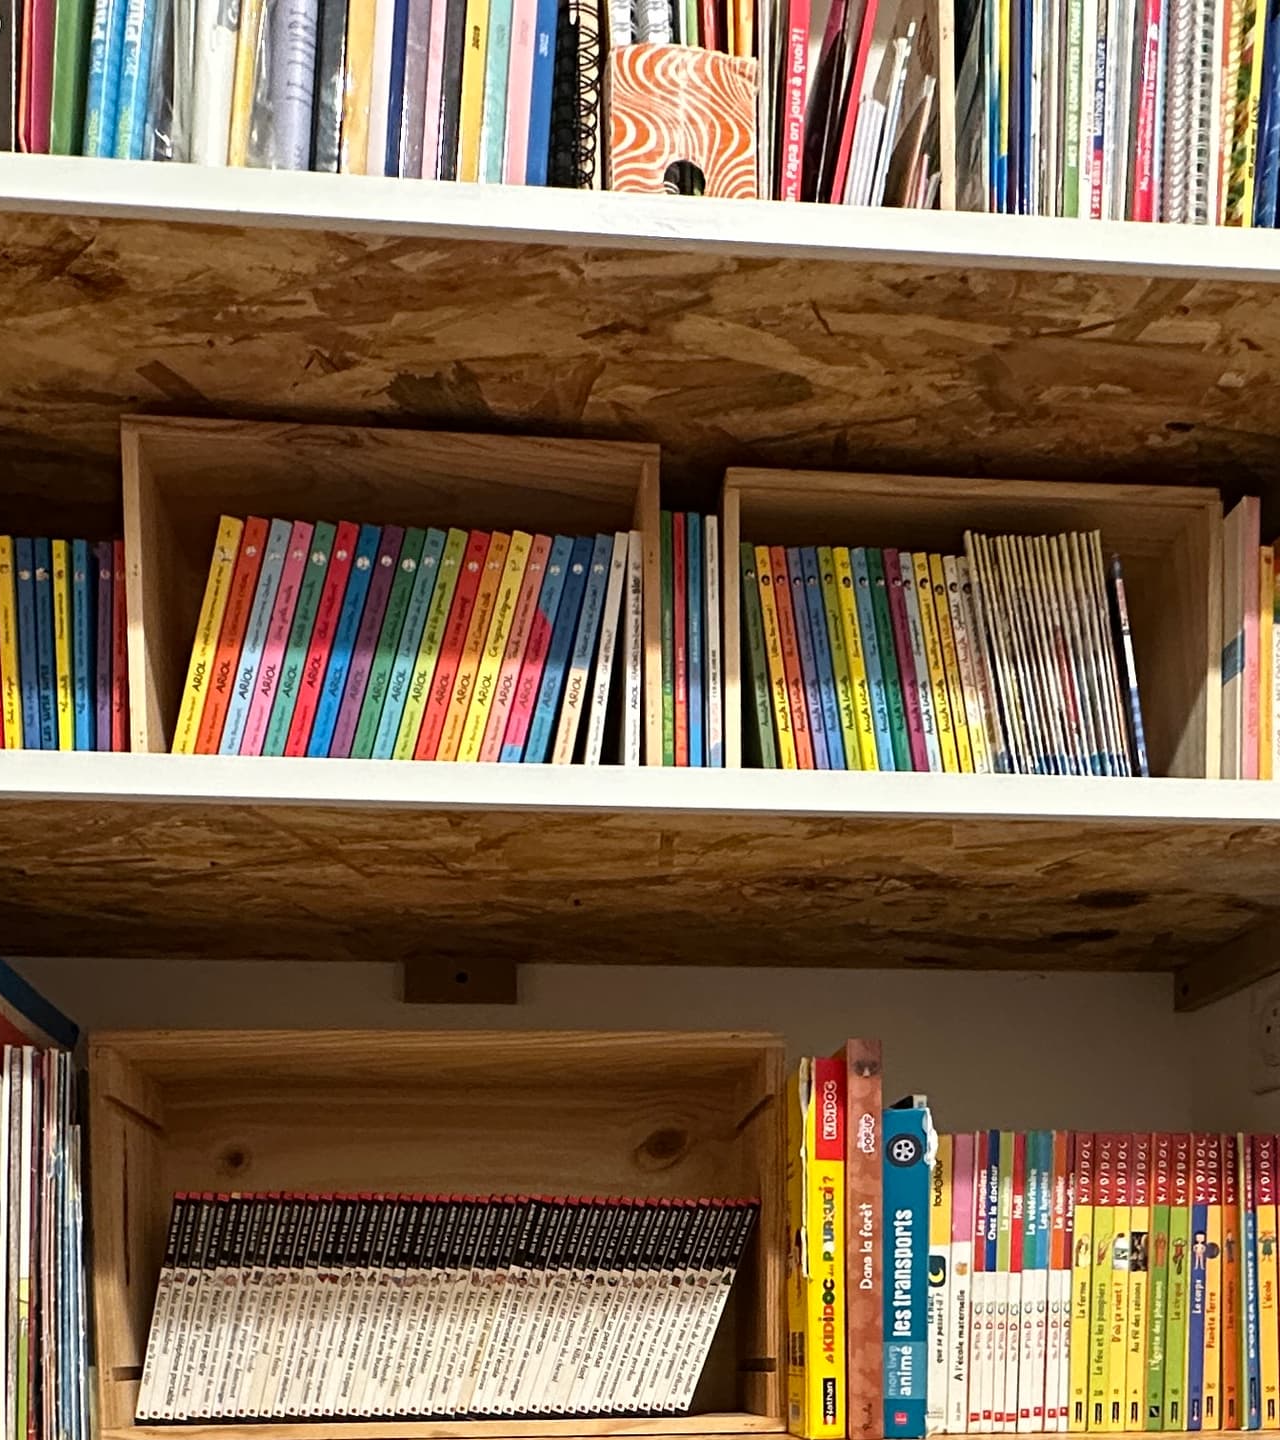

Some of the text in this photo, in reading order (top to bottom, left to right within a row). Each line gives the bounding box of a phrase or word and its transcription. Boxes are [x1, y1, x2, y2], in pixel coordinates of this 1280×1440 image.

[790, 90, 803, 121] joue
[790, 123, 799, 141] on
[786, 144, 799, 179] Papa
[858, 1203, 873, 1290] Dans la forêt
[891, 1209, 915, 1337] les transports
[895, 1345, 913, 1397] animé
